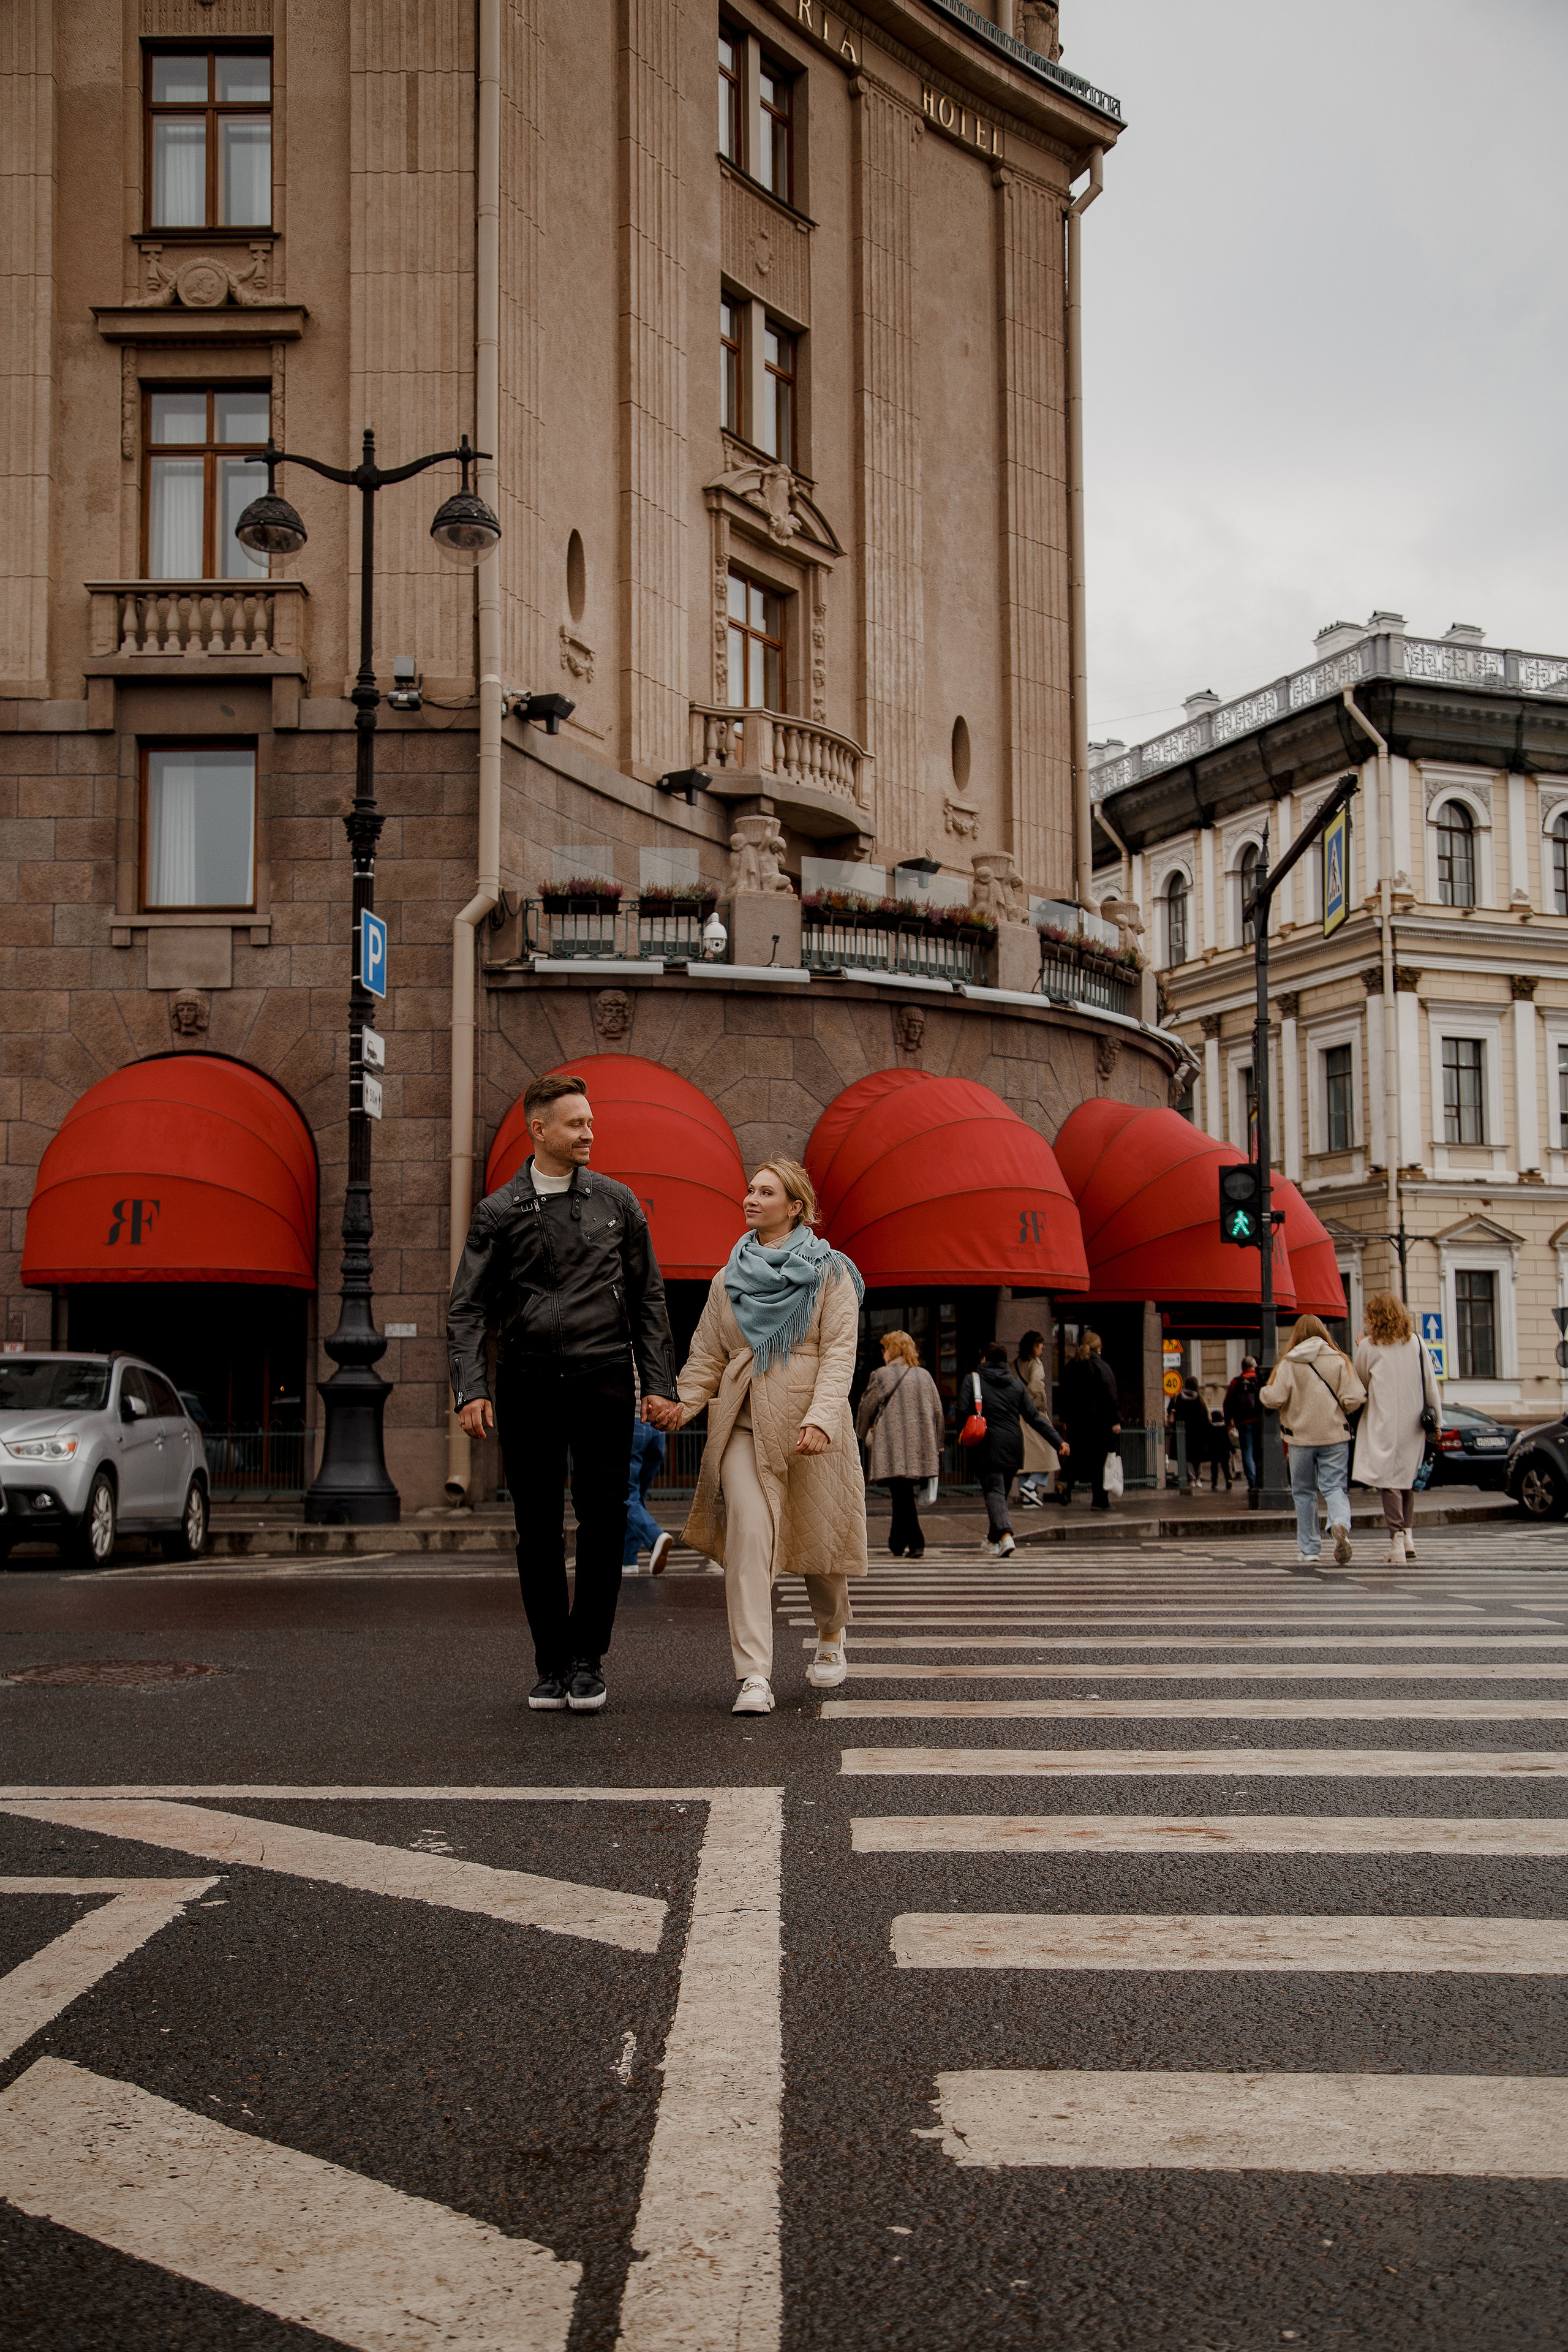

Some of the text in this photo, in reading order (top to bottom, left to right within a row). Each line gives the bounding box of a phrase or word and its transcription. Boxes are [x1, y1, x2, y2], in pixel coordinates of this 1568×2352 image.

[921, 81, 1003, 158] HOTEL
[369, 923, 383, 981] P
[1166, 1378, 1178, 1388] 40
